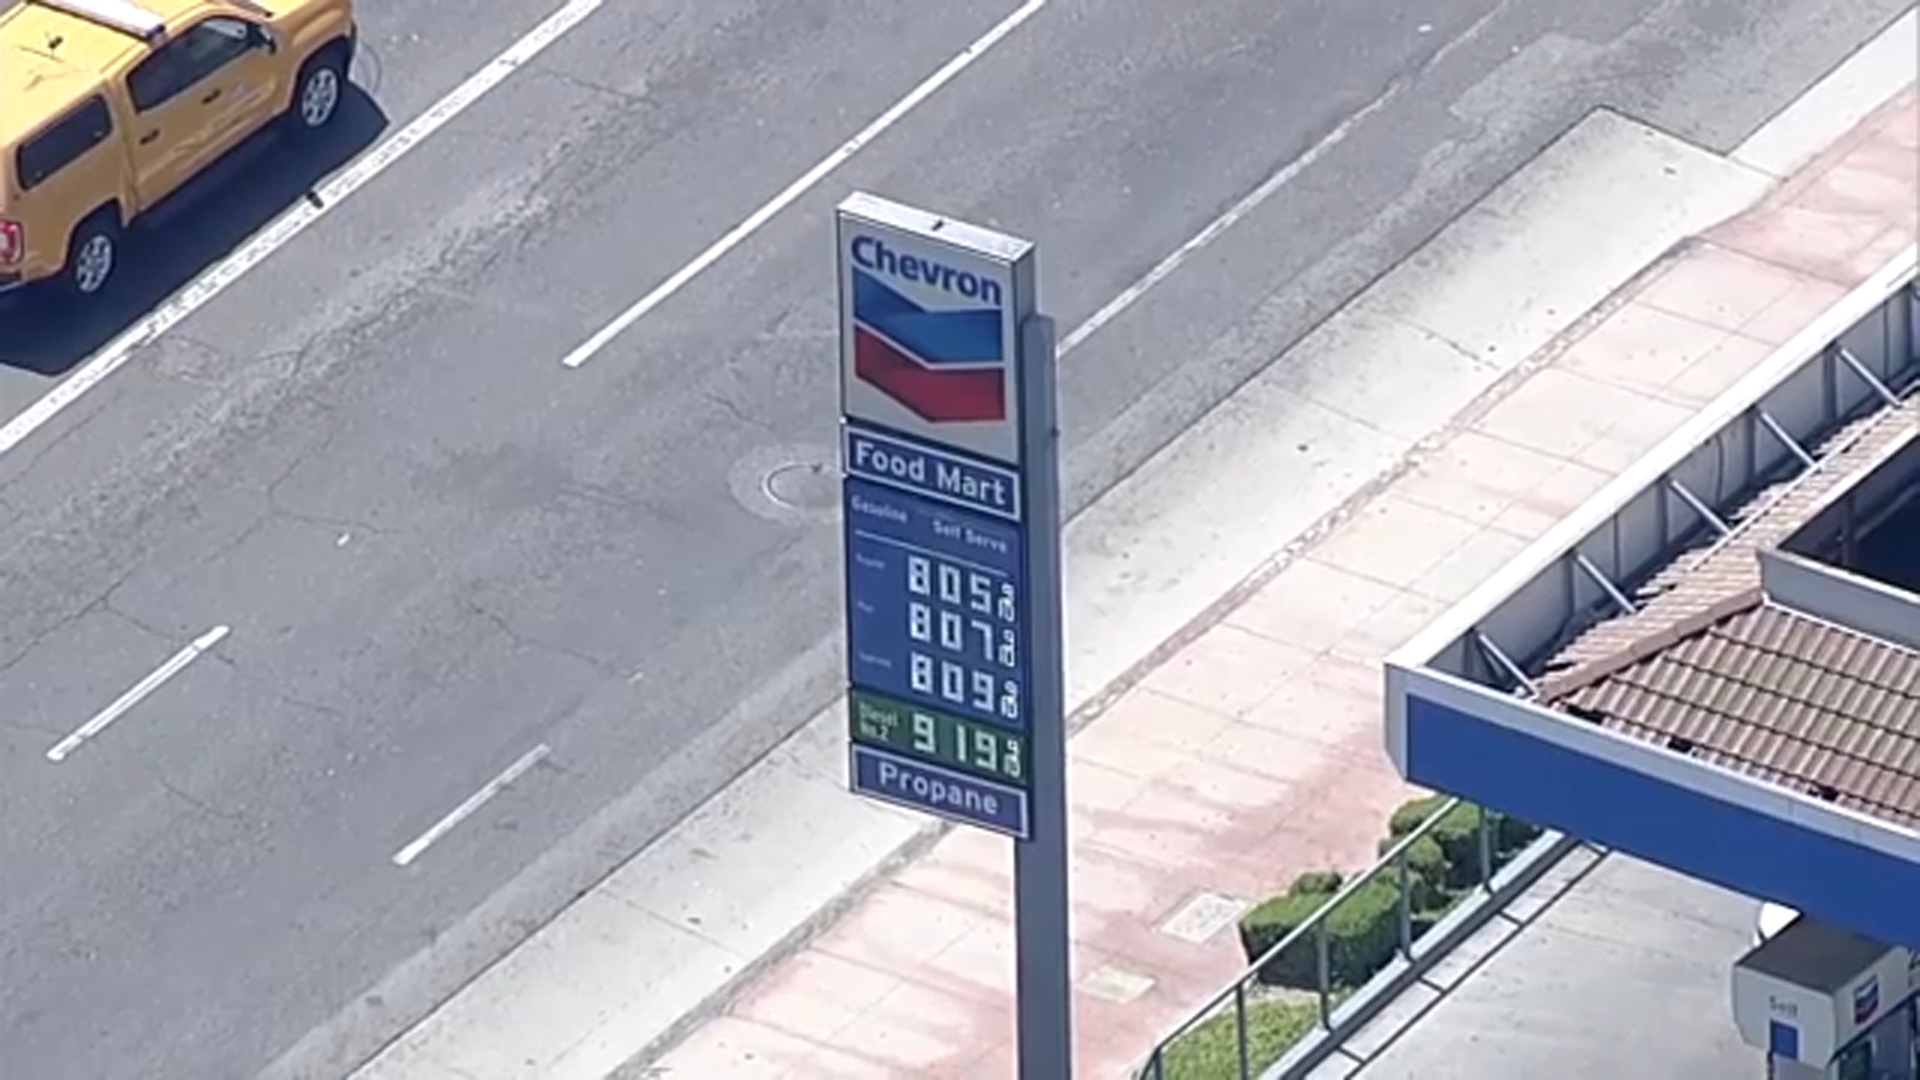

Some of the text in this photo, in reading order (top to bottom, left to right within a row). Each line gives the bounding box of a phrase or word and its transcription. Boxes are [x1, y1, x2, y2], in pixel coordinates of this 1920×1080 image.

[852, 236, 1002, 305] Chevron
[855, 441, 1006, 505] Food Mart
[851, 495, 908, 524] Gasoline
[932, 520, 1008, 553] Self Serve
[908, 556, 992, 614] 805
[909, 602, 993, 662] 807
[911, 652, 995, 712] 809
[913, 713, 998, 772] 919
[879, 763, 998, 814] Propane
